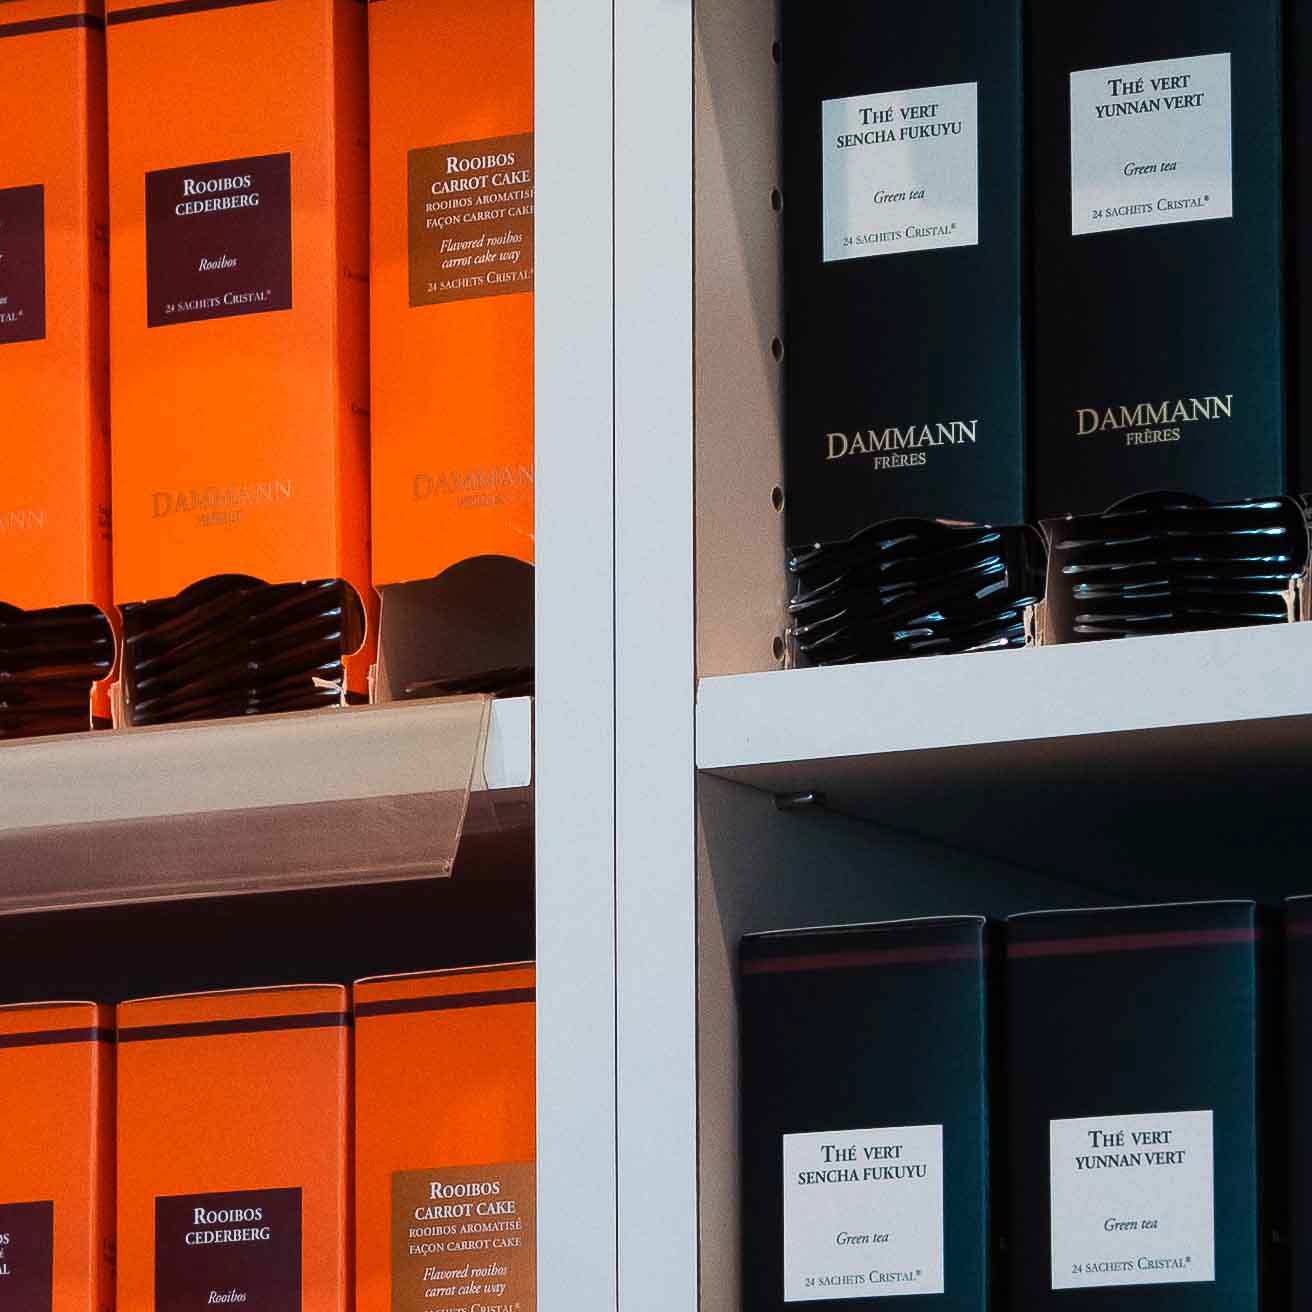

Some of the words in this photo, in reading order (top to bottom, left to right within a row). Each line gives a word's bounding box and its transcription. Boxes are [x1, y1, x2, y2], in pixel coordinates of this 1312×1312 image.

[859, 105, 894, 126] THÉ
[900, 104, 939, 120] VERT
[836, 127, 896, 149] SENCHA
[899, 122, 962, 141] FUKUYU
[183, 175, 251, 196] ROOIBOS
[873, 189, 907, 204] Green
[910, 188, 925, 201] tea
[175, 193, 259, 216] CEDERBERG
[199, 256, 237, 271] Rooibos
[826, 420, 978, 460] DAMMANN
[1088, 1130, 1124, 1149] THÉ
[1131, 1130, 1172, 1145] VERT
[821, 1144, 857, 1165] THÉ
[863, 1144, 903, 1160] VERT
[1075, 1153, 1141, 1170] YUNNAN
[1147, 1150, 1186, 1165] VERT
[798, 1167, 859, 1186] SENCHA
[863, 1164, 927, 1180] FUKUYU
[430, 1182, 500, 1200] ROOIBOS
[415, 1204, 472, 1221] CARROT
[476, 1201, 516, 1216] CAKE
